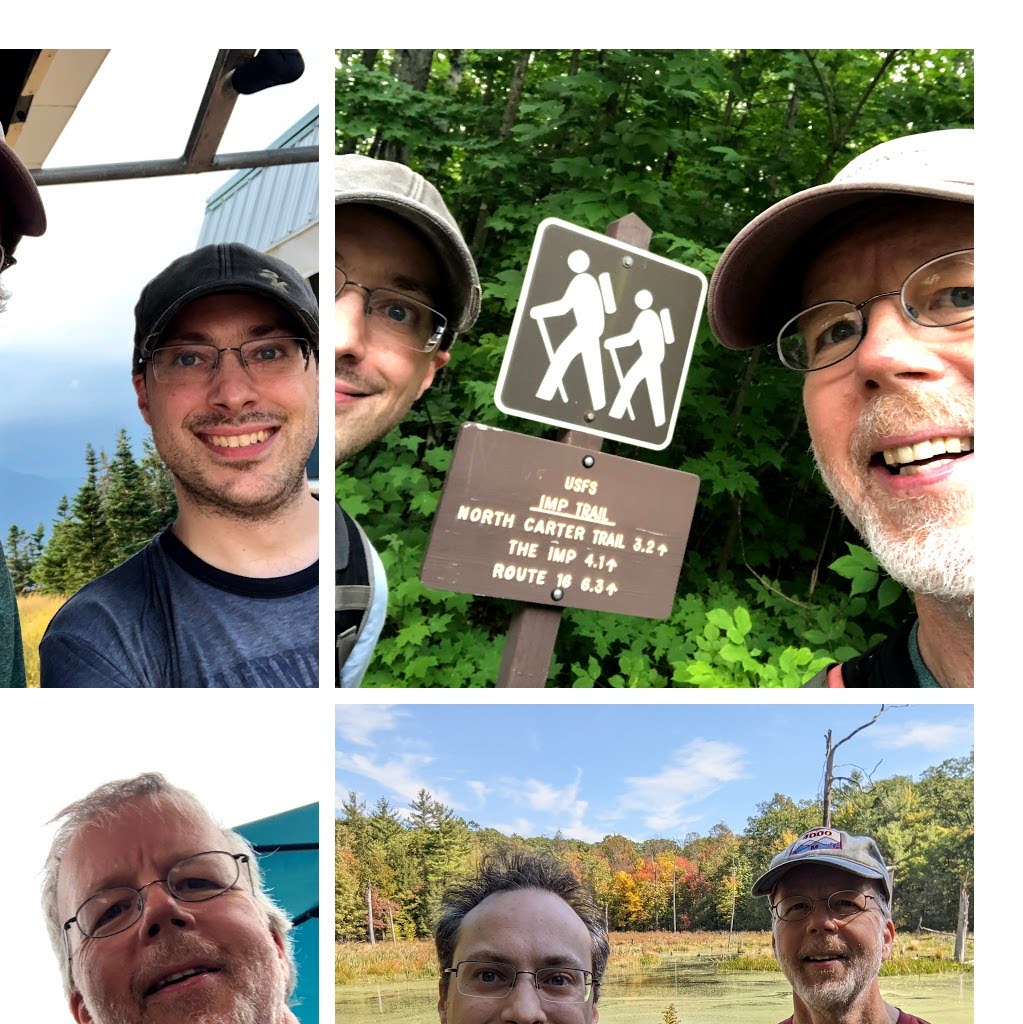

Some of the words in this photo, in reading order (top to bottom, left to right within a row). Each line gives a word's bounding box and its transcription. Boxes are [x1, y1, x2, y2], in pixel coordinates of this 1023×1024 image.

[564, 476, 598, 495] USFS
[539, 495, 568, 511] IMP
[576, 502, 609, 522] TRAIL
[457, 505, 516, 528] NORTH
[524, 518, 585, 541] CARTER
[592, 529, 626, 549] TRAIL
[633, 537, 655, 554] 3.2
[509, 540, 537, 558] THE
[547, 546, 577, 564] IMP
[584, 553, 605, 570] 4.1
[492, 563, 547, 585] ROUTE
[557, 573, 572, 589] 16
[581, 577, 604, 594] 6.3
